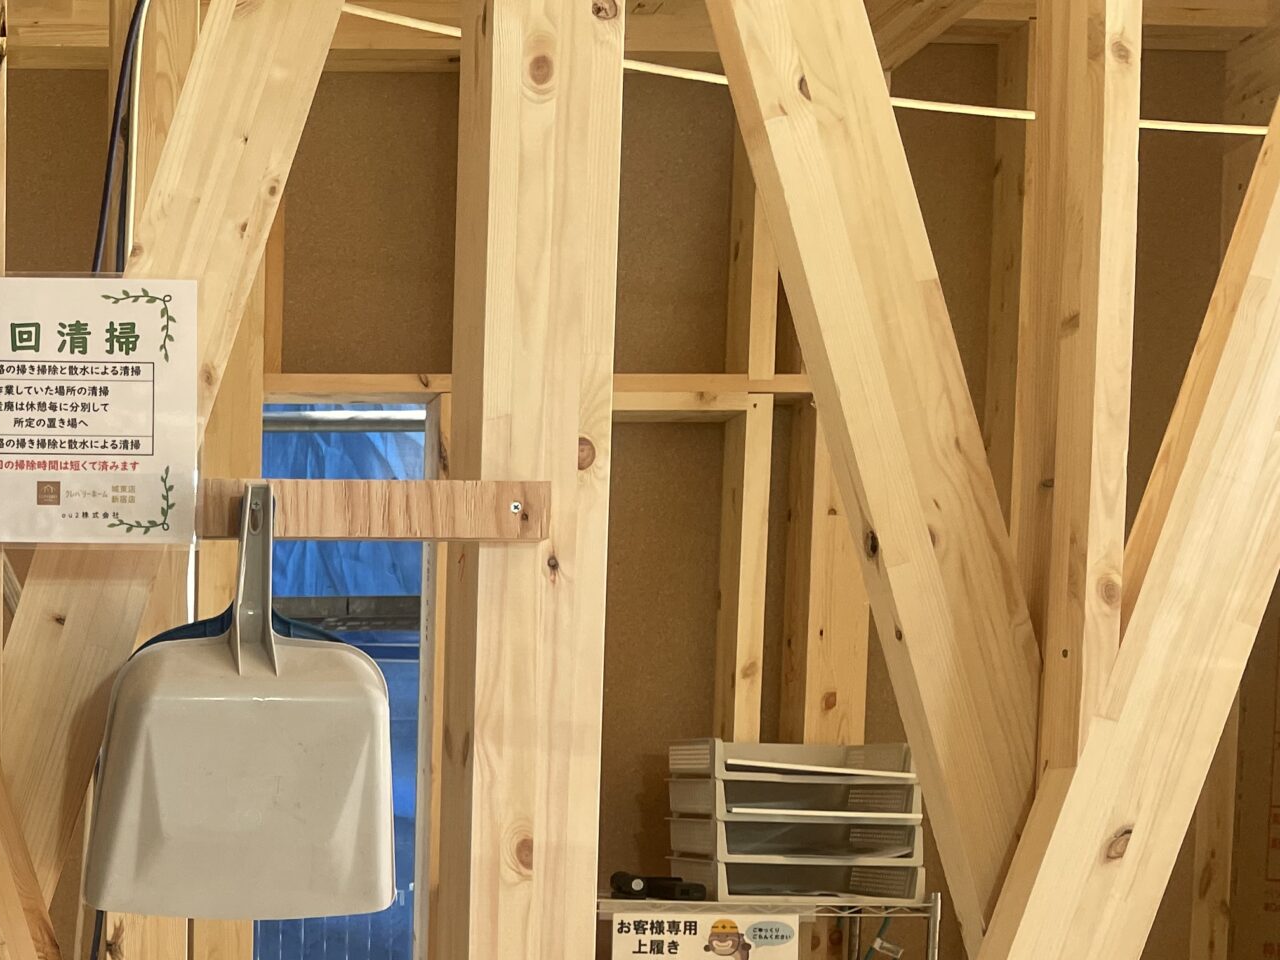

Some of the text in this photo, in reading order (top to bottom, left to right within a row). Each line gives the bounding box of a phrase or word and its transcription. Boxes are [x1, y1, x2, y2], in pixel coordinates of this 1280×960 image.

[13, 417, 89, 428] 所定の置き場へ
[616, 919, 698, 935] お客様専用
[632, 939, 681, 955] 上履き
